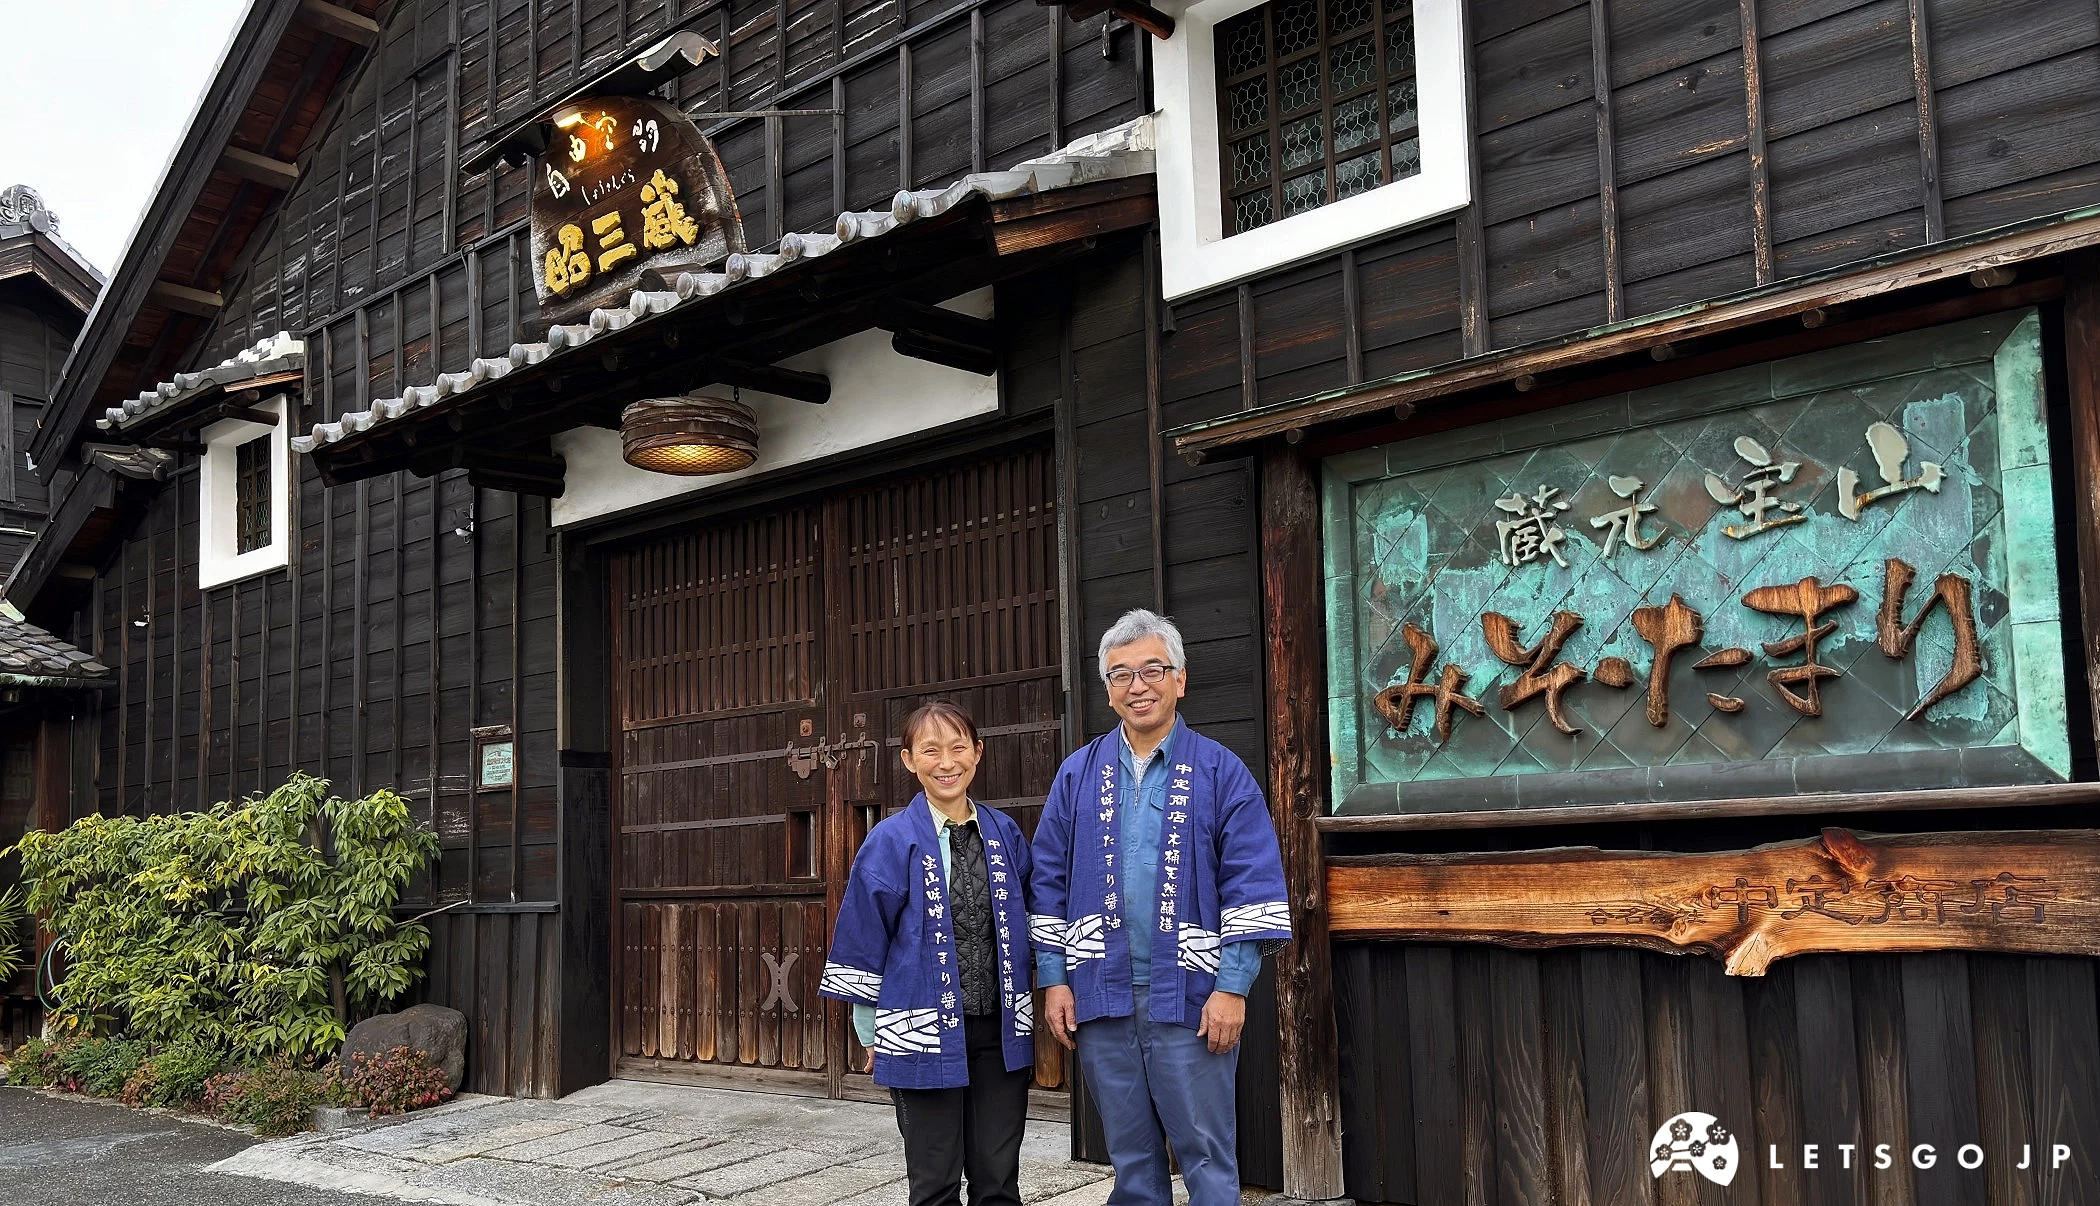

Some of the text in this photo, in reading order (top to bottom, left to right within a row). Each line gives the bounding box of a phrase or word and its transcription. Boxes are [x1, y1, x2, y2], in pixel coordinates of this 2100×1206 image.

[545, 169, 699, 295] 昭三蔵
[1494, 420, 1947, 568] 蔵元宝山
[1709, 872, 2058, 926] 中定商店
